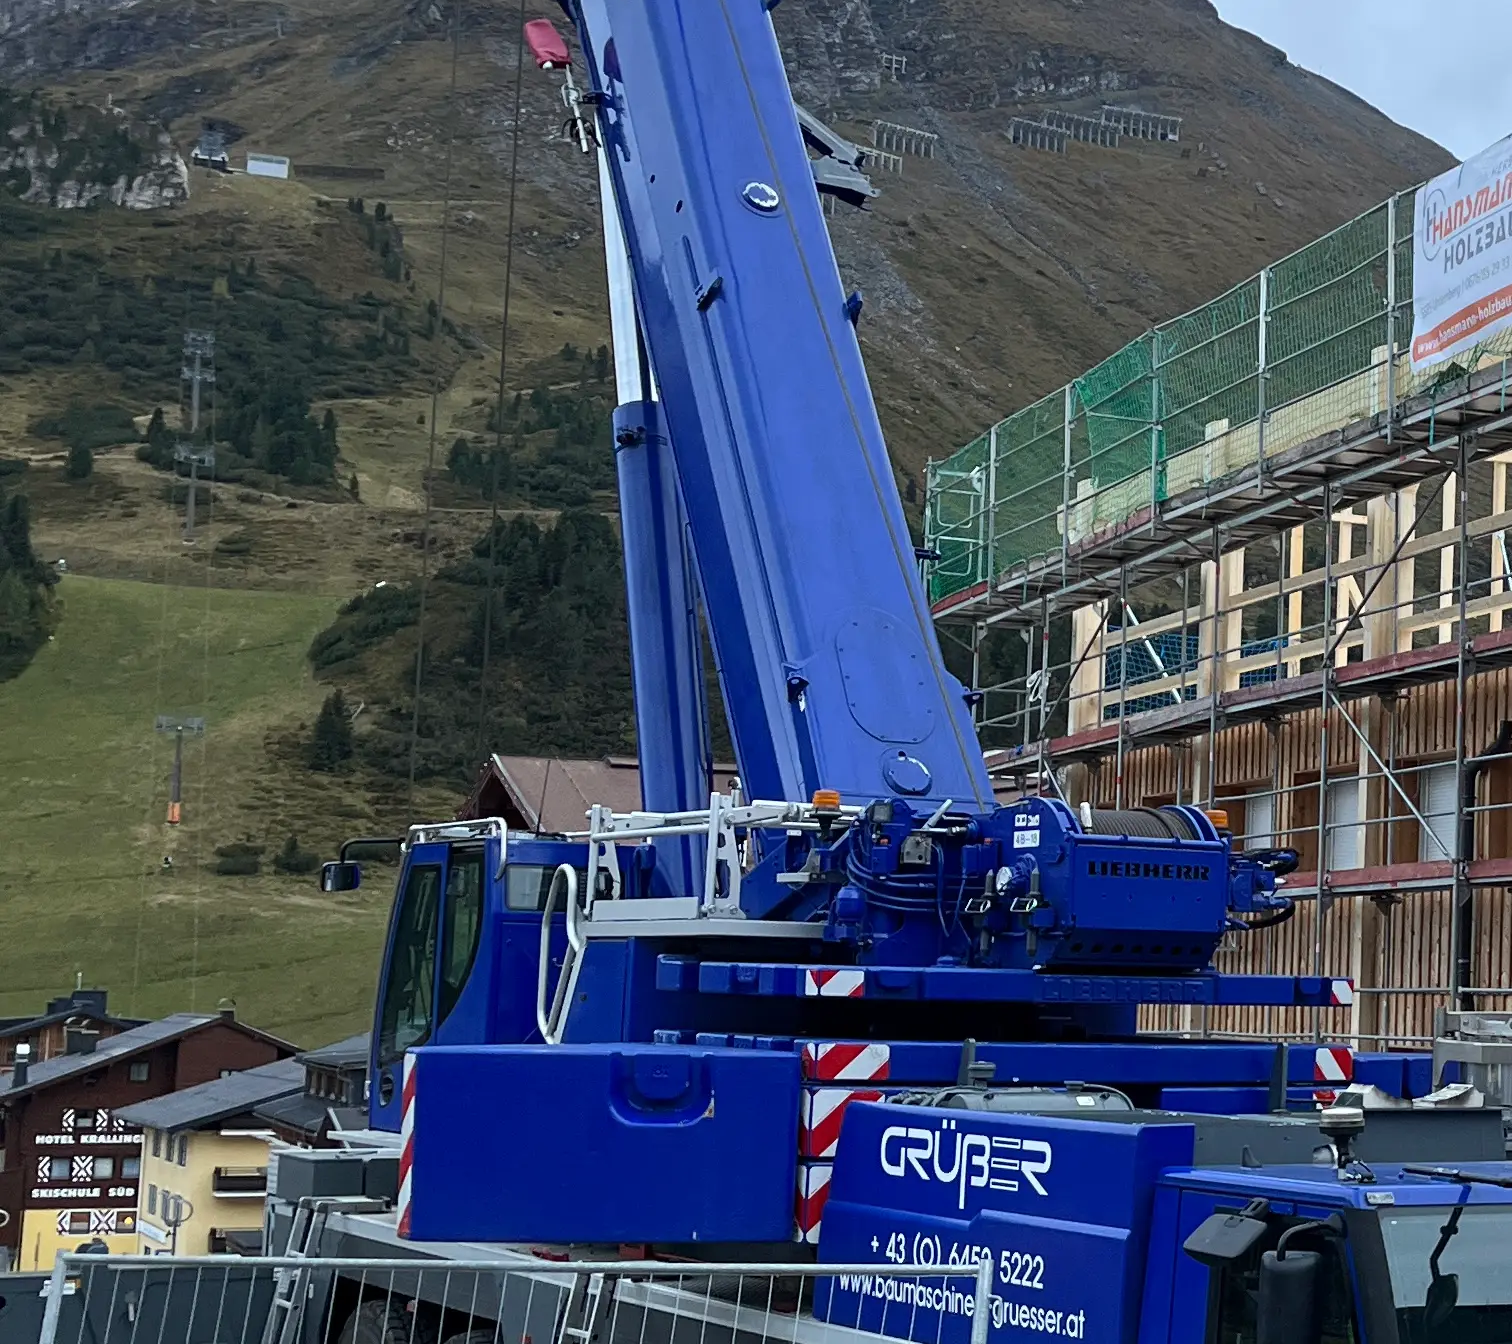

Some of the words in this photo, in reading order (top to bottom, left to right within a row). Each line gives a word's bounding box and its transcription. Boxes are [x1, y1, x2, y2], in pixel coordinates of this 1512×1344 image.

[1088, 860, 1211, 881] LIEBHERR
[35, 1134, 75, 1144] HOTEL
[80, 1134, 143, 1144] KRALLING
[880, 1119, 1052, 1209] GRÜßER
[31, 1187, 101, 1198] SKISCHULE
[108, 1185, 136, 1197] SÜD
[885, 1232, 906, 1264] 43
[913, 1232, 942, 1266] (0)
[1000, 1250, 1044, 1290] 5222
[839, 1274, 1086, 1339] www.baumaschine-gruesser.at
